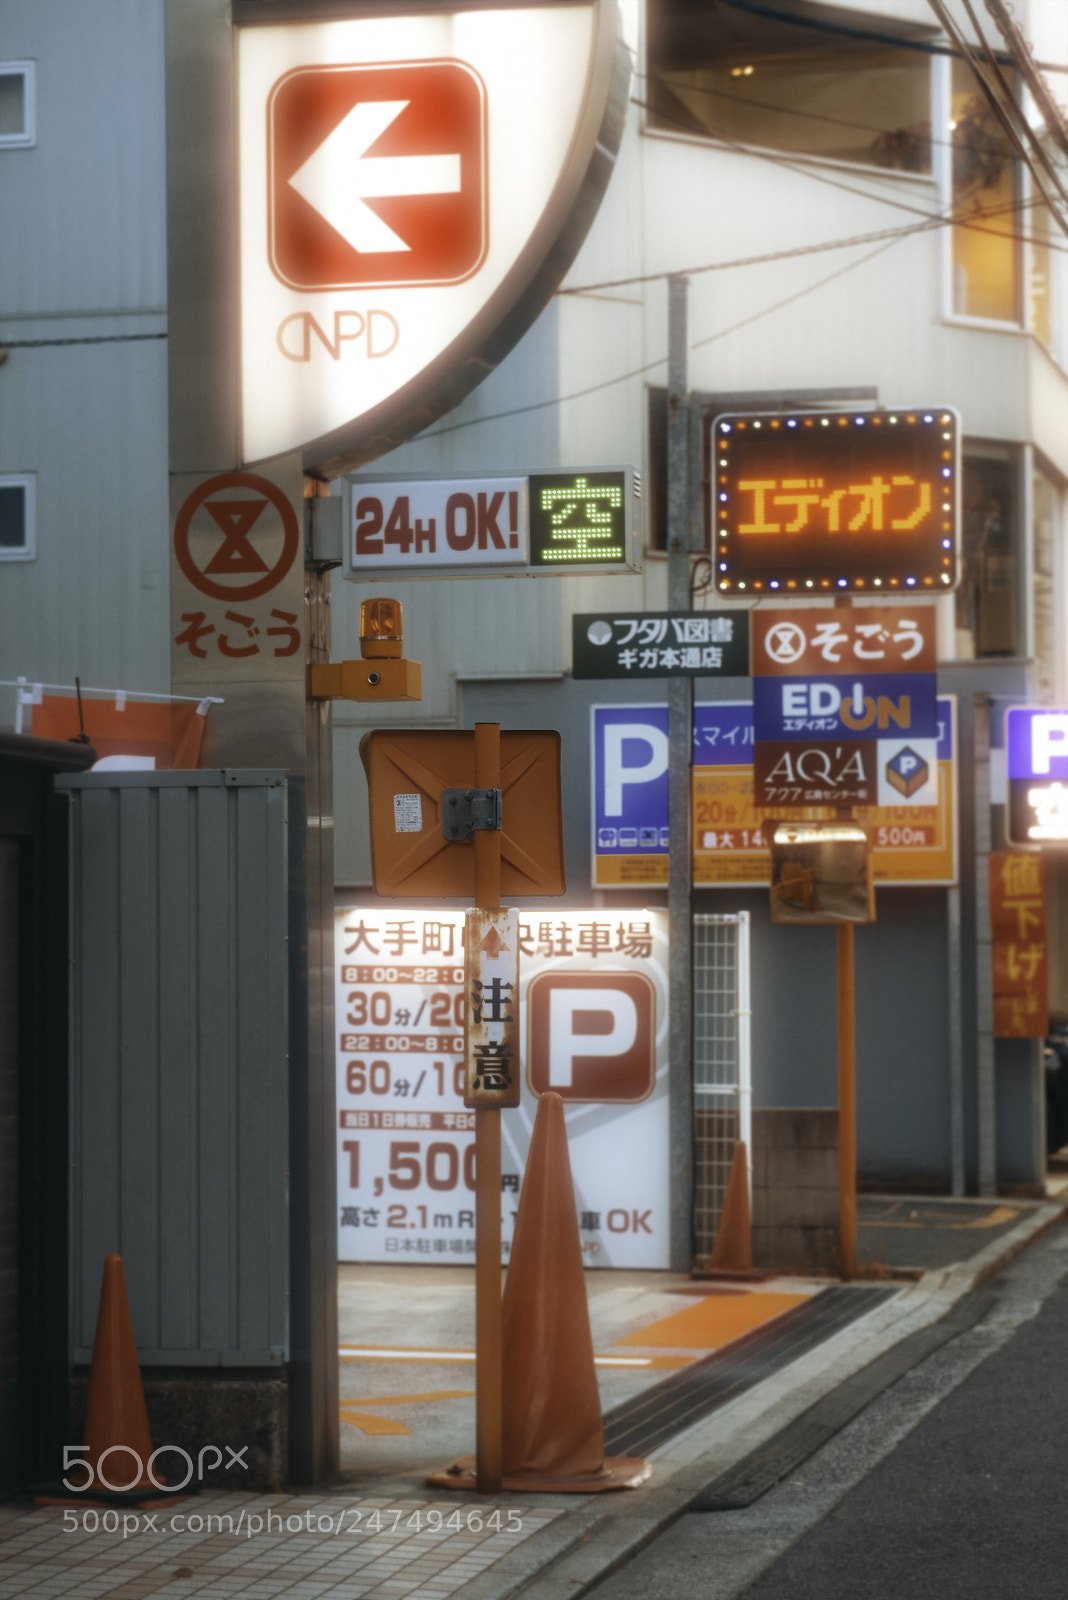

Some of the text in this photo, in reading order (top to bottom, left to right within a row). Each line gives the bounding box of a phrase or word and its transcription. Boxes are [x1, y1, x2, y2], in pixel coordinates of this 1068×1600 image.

[356, 490, 519, 555] 24H OK!
[542, 478, 621, 560] 空
[738, 475, 932, 534] エディオン
[174, 608, 301, 659] そごう
[613, 616, 734, 646] フタバ図書
[617, 646, 723, 669] ギガ本通店
[810, 619, 925, 663] そごう
[781, 682, 911, 731] EDION
[782, 717, 839, 732] エディオン
[604, 723, 670, 817] P
[1031, 714, 1068, 775] P
[471, 977, 514, 1091] 注意
[550, 988, 638, 1087] P
